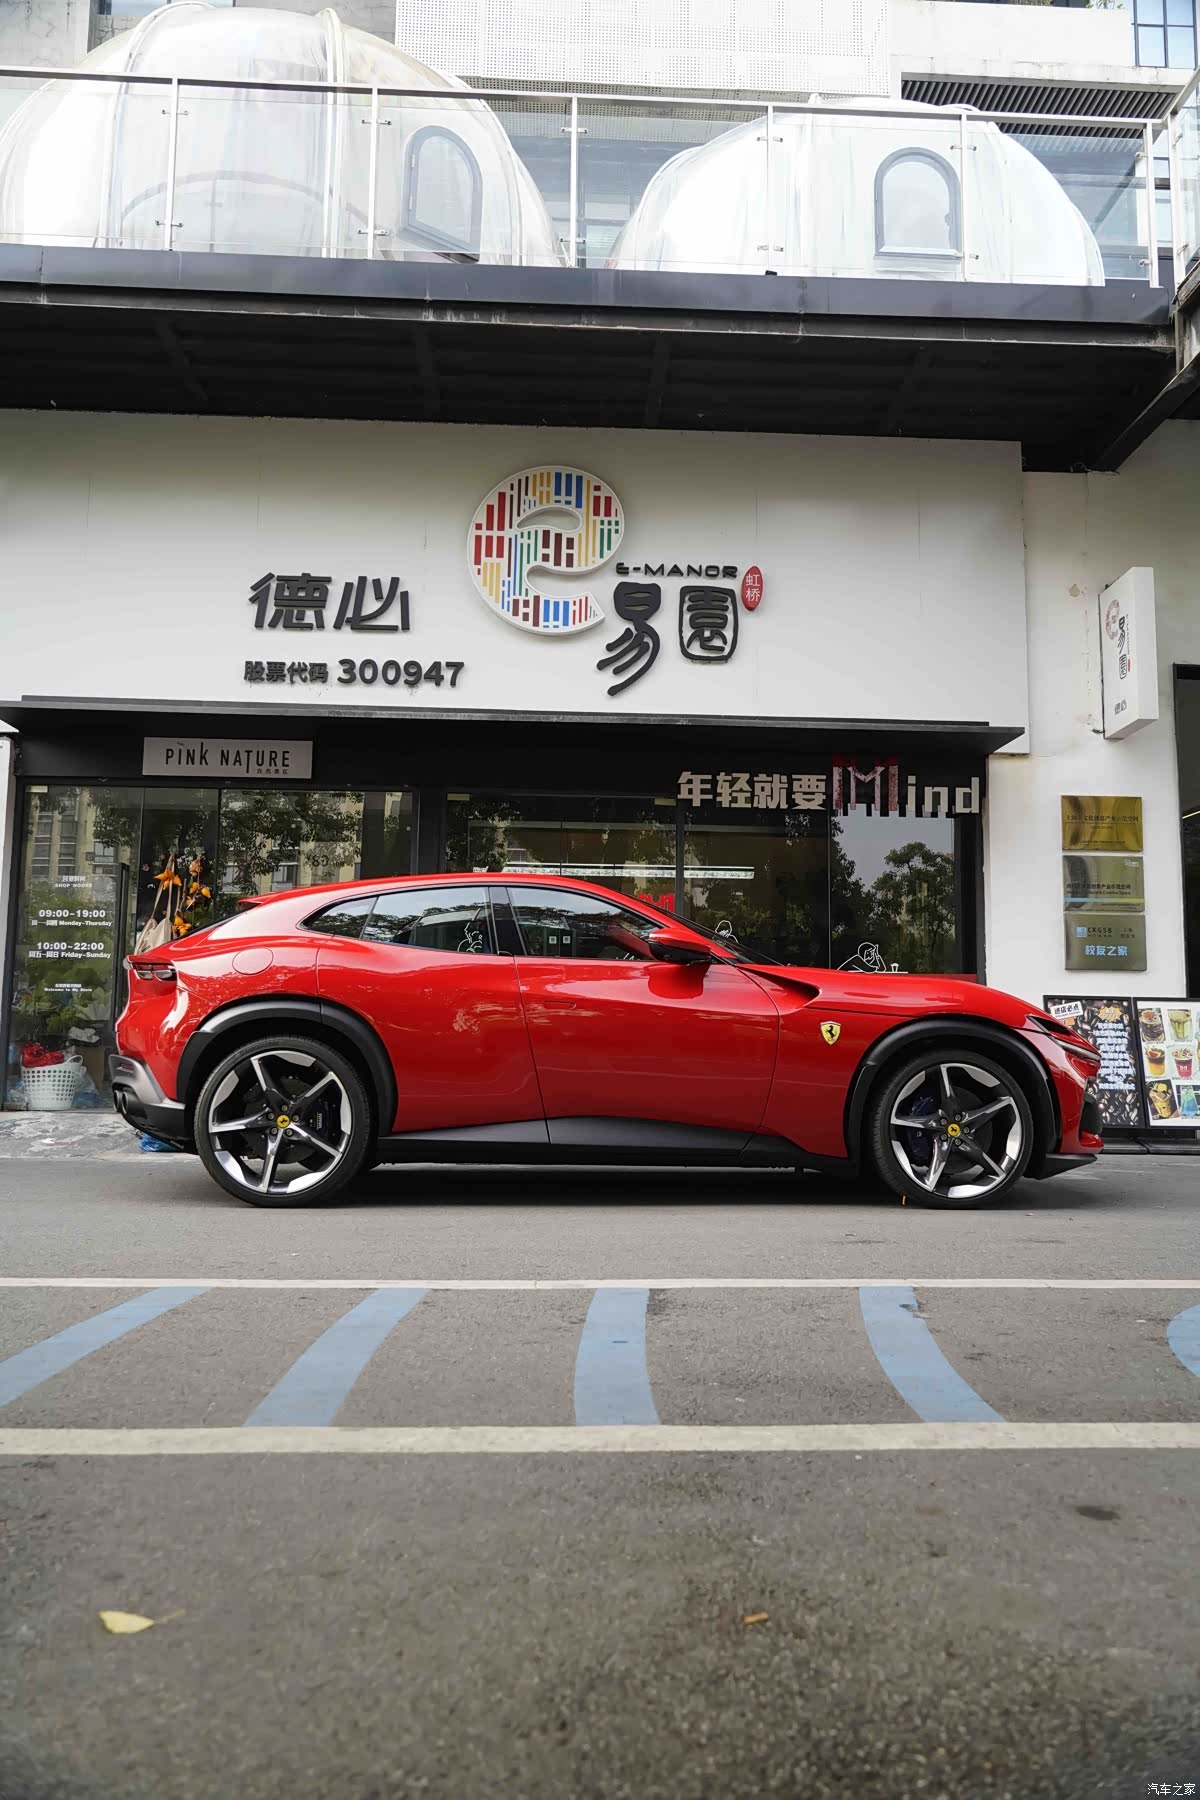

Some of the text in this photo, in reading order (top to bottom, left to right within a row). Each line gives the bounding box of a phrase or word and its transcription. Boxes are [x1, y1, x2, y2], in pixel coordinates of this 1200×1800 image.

[615, 562, 738, 578] E-MANOR
[248, 572, 410, 632] 德必
[744, 572, 761, 604] 虹桥
[244, 658, 464, 688] 股票代码 300947
[220, 749, 290, 774] NATURE
